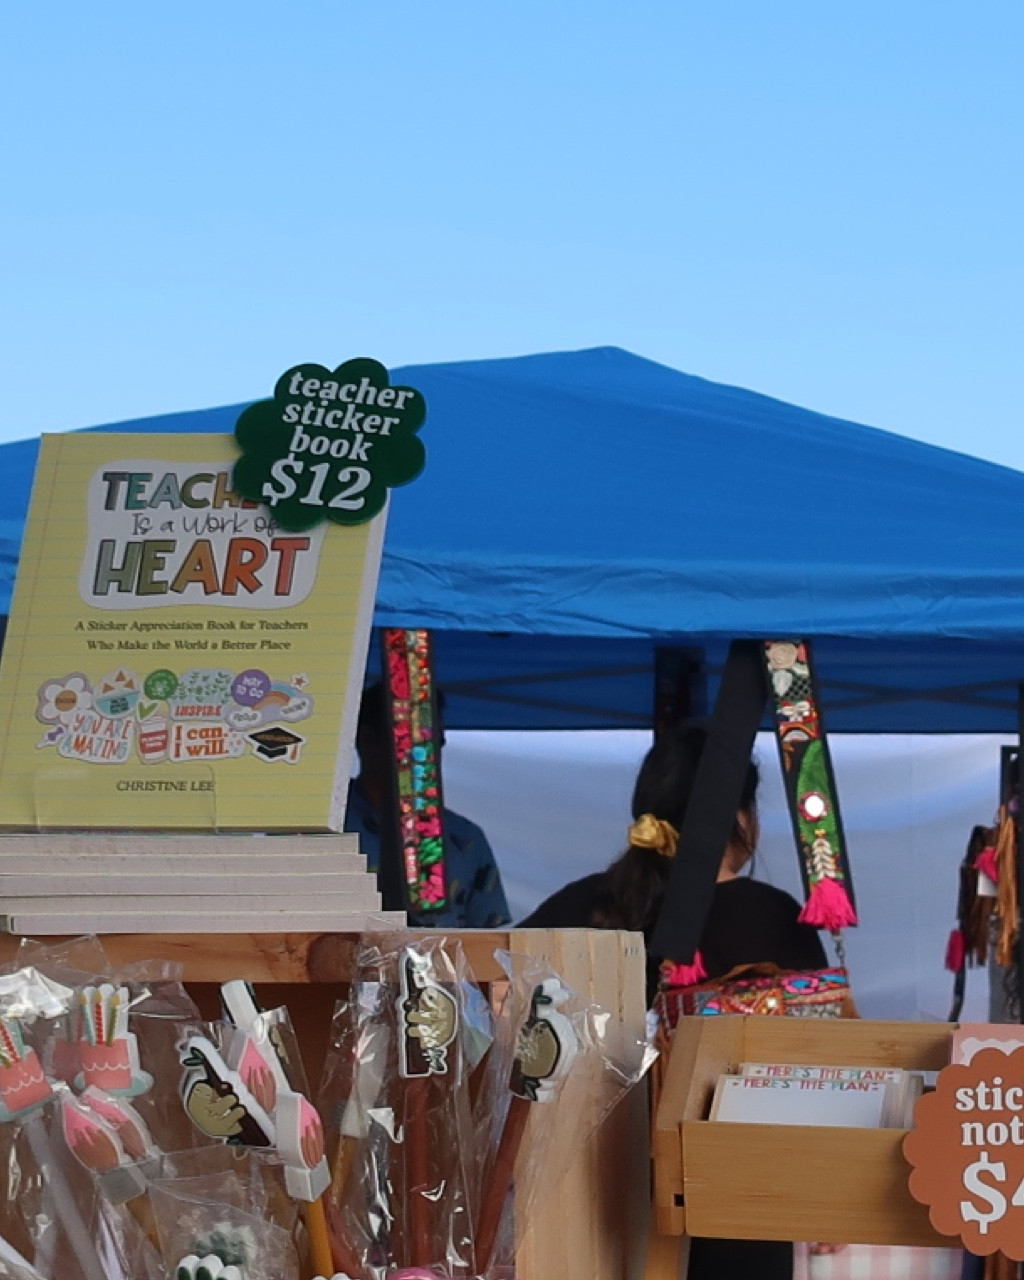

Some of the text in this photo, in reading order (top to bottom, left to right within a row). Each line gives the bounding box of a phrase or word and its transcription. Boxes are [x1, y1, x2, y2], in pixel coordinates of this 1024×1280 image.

[288, 371, 414, 410] teacher
[282, 400, 400, 436] sticker
[290, 426, 373, 461] book
[262, 452, 372, 510] $12
[102, 472, 267, 511] TEACH
[132, 512, 153, 536] Is
[159, 519, 175, 534] a
[182, 513, 244, 535] Work
[93, 537, 311, 596] HEART
[75, 620, 309, 633] A Sticker Appreciation Book for Teachers
[87, 640, 114, 650] Who
[117, 640, 149, 650] Make
[152, 640, 171, 650] the
[174, 640, 208, 650] World
[222, 640, 258, 650] Better
[260, 640, 292, 650] Place
[174, 705, 222, 717] INSPIRE
[174, 725, 229, 741] I can.
[175, 743, 182, 758] I
[186, 740, 230, 756] will.
[116, 780, 215, 792] CHRISTINE LEE
[819, 1068, 844, 1080] THE
[850, 1070, 886, 1081] PLAN
[799, 1080, 826, 1090] THE
[831, 1081, 869, 1091] PLAN
